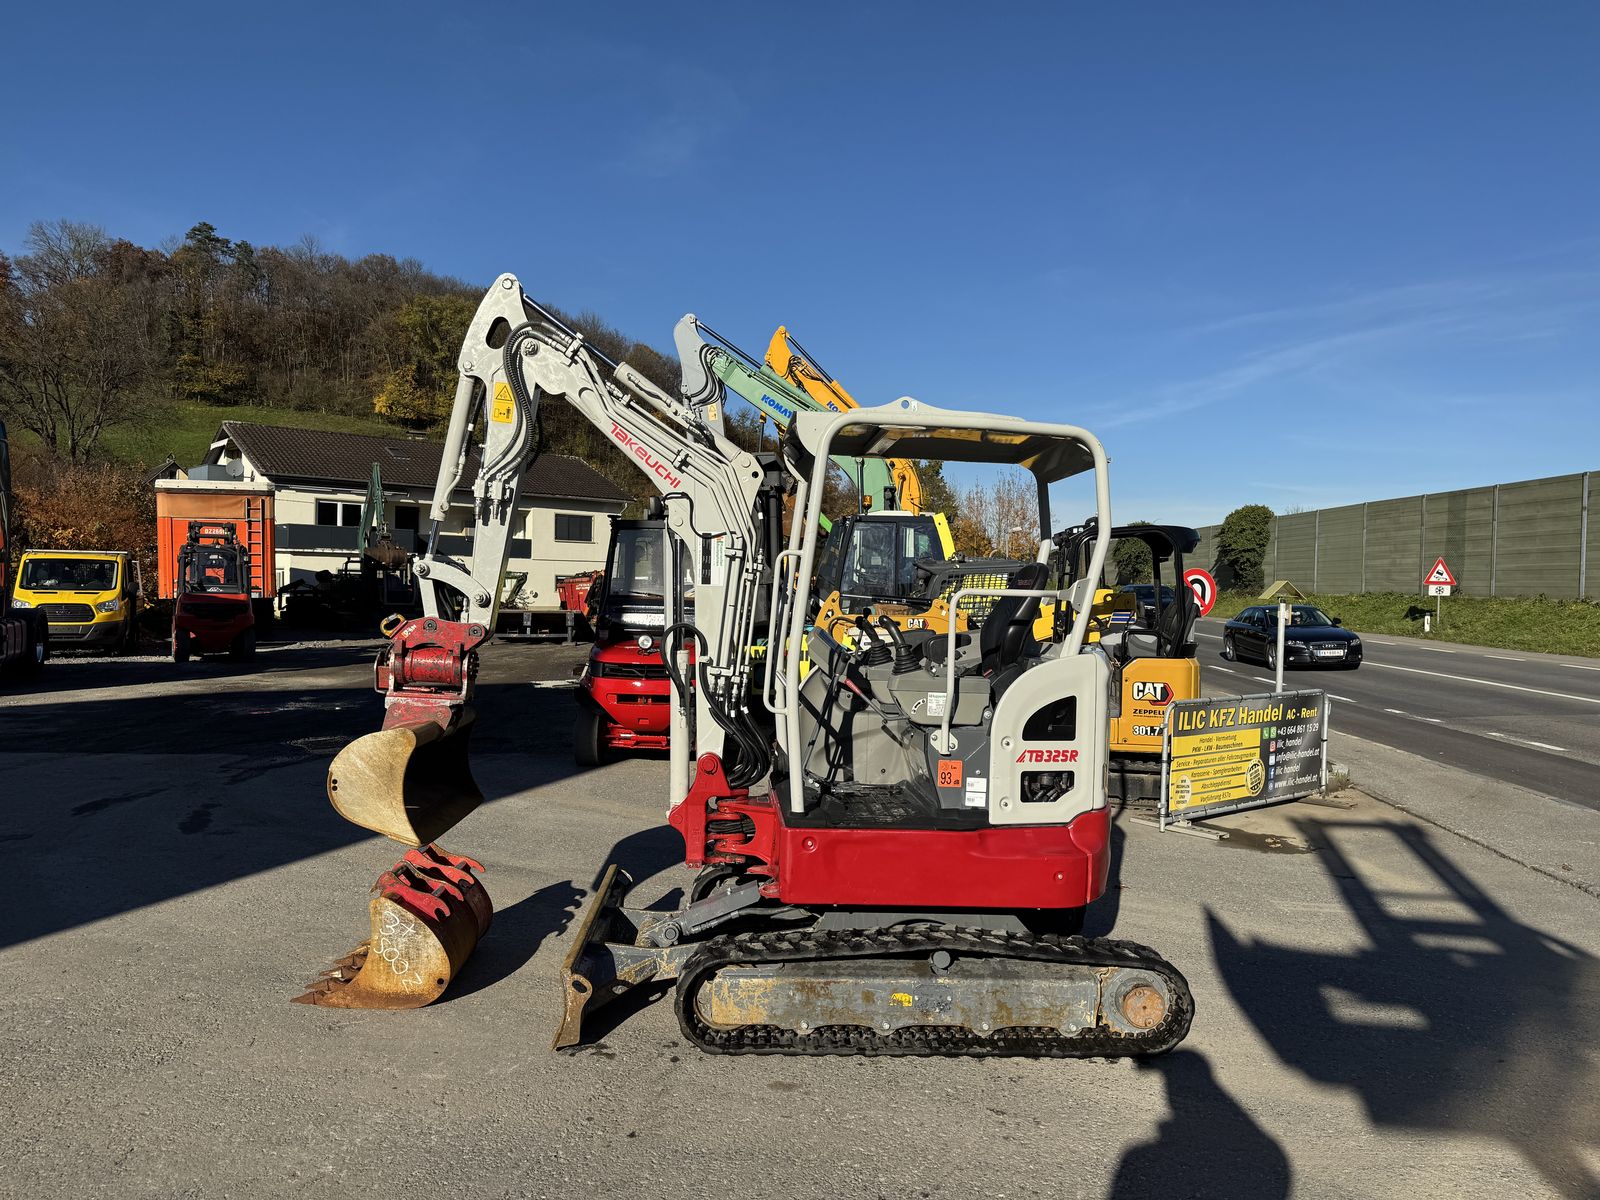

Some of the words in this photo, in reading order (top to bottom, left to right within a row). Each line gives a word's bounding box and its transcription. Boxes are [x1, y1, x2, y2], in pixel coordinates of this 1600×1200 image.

[761, 394, 793, 419] KOMAT
[907, 618, 924, 629] CAT
[1132, 682, 1164, 701] CAT
[1178, 709, 1206, 731] ILIC
[1209, 707, 1236, 728] KFZ
[1238, 703, 1283, 725] Handel
[1301, 707, 1318, 719] Rent
[1027, 749, 1079, 763] TB325R
[940, 771, 952, 785] 93
